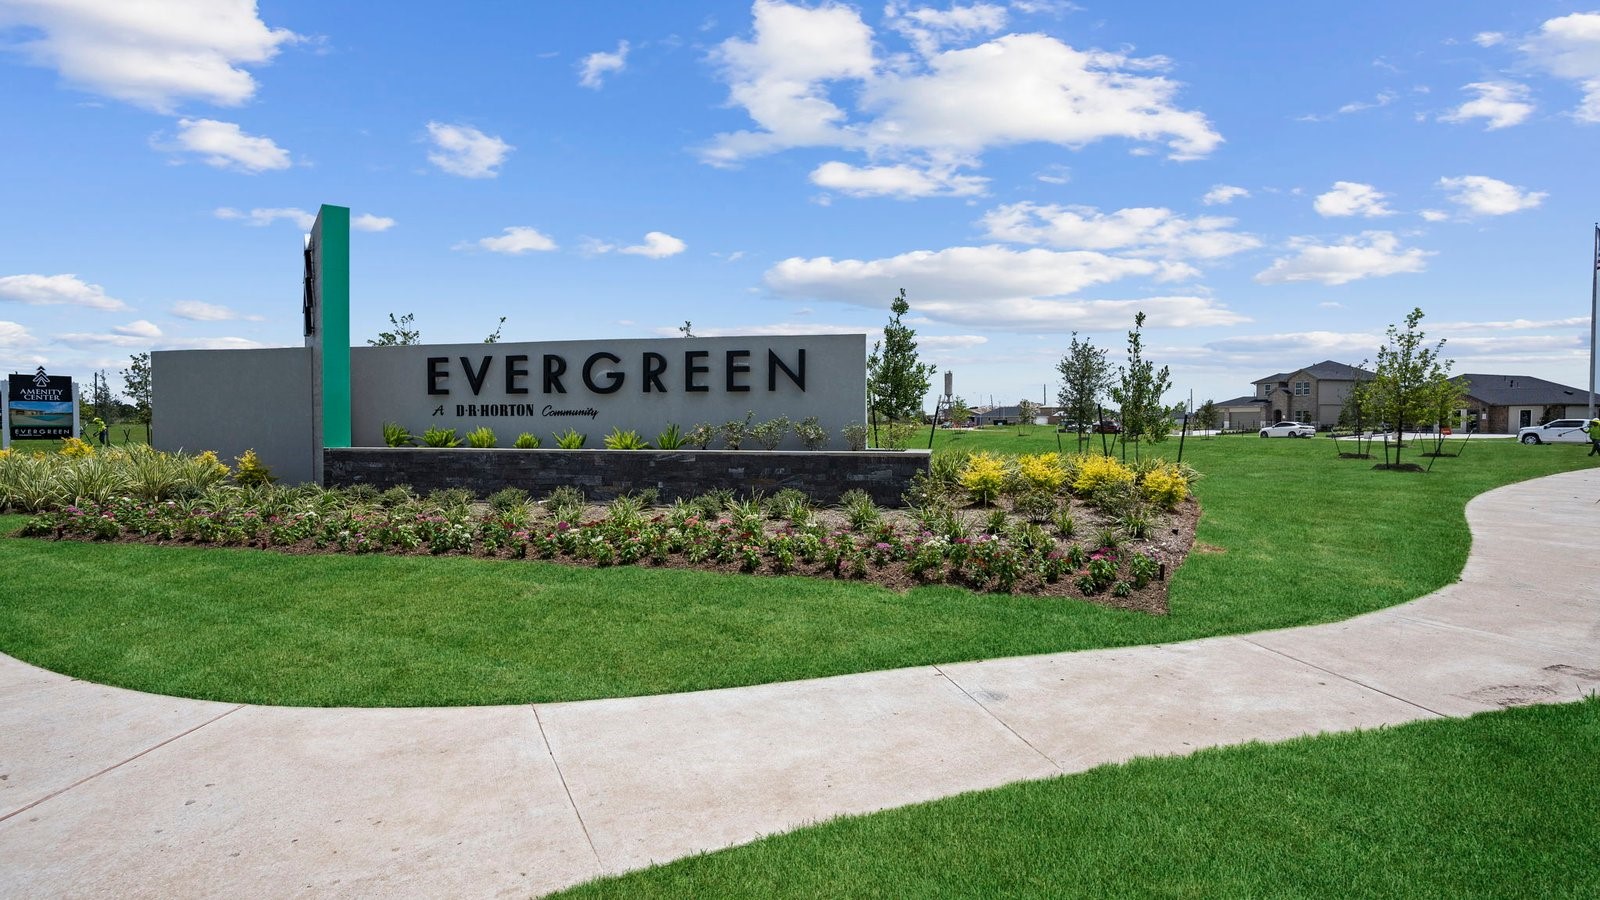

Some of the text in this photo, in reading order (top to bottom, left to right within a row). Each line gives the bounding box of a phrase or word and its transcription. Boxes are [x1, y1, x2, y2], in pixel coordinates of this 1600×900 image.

[427, 348, 806, 396] EVERGREEN
[432, 404, 445, 417] A
[541, 404, 599, 420] Community
